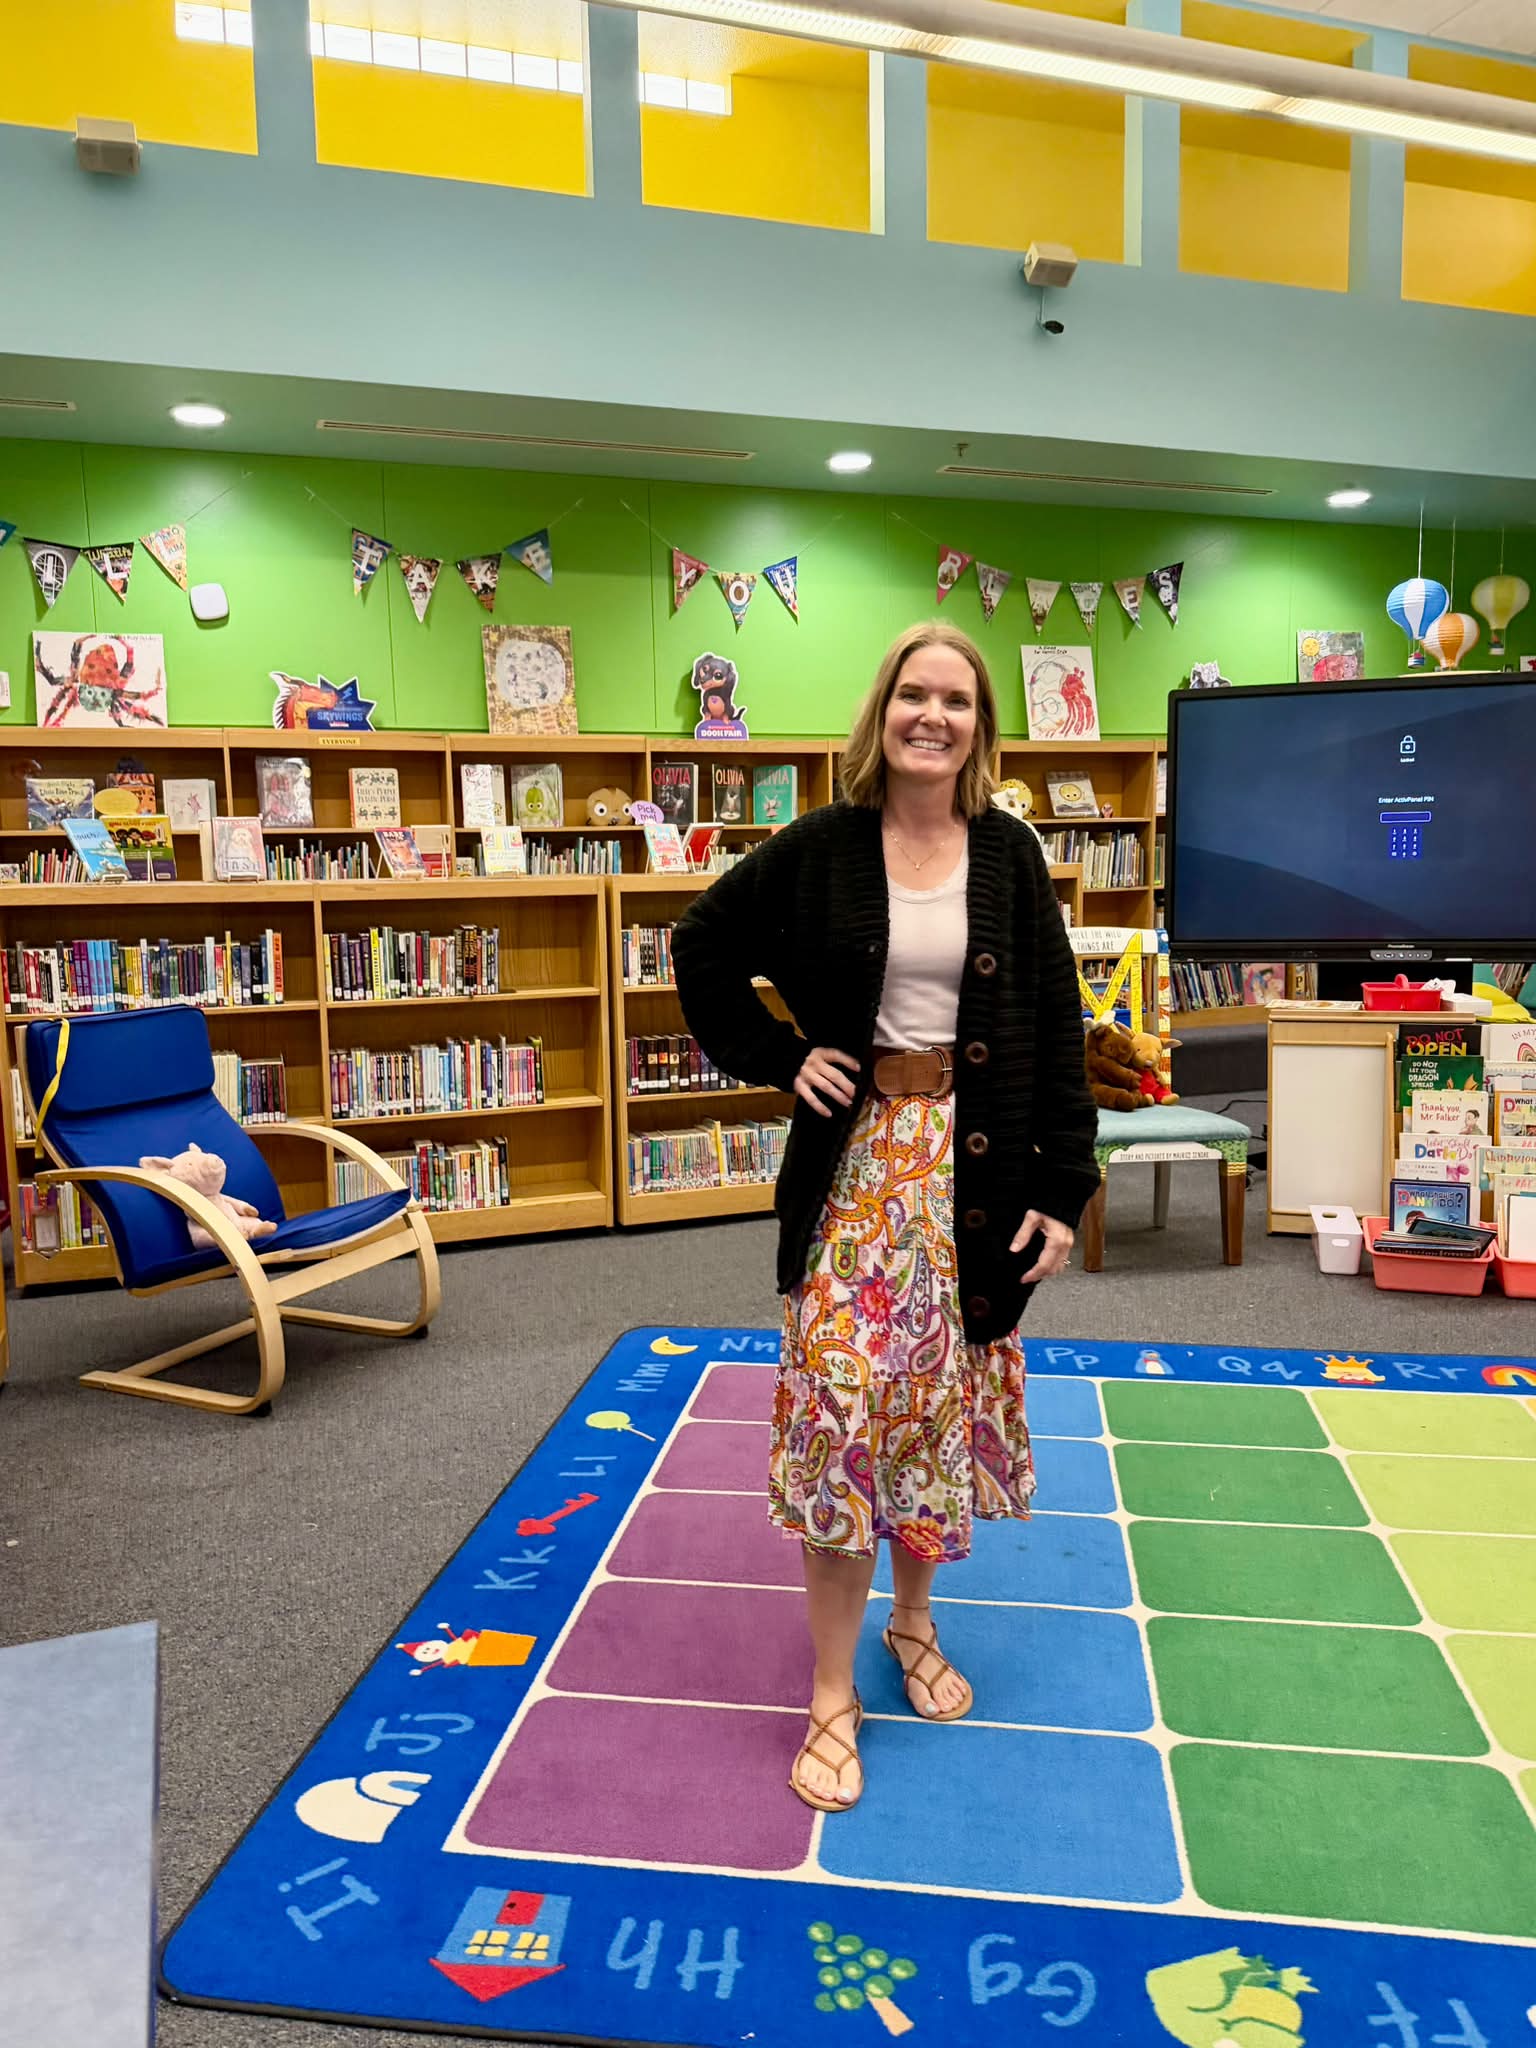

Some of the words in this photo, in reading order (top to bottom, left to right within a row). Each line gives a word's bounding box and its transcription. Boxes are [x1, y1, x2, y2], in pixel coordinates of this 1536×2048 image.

[317, 711, 363, 722] SKYWINGS
[701, 729, 721, 737] BOOK
[724, 729, 742, 737] FAIR
[653, 767, 691, 786] OLIVIA
[715, 768, 745, 786] OLIVIA
[755, 769, 790, 787] OLIVIA
[637, 804, 656, 814] Pick
[1102, 941, 1115, 951] ARE
[1405, 1034, 1432, 1049] DO
[1435, 1028, 1465, 1043] NOT
[1406, 1041, 1467, 1056] OPEN
[1408, 1073, 1439, 1081] DRAGON
[1420, 1104, 1445, 1112] Thank
[1436, 1113, 1460, 1121] Falker
[719, 1336, 777, 1353] Nn
[1044, 1346, 1100, 1370] Pp
[616, 1363, 671, 1392] Mm
[1217, 1355, 1303, 1382] Qq
[1393, 1361, 1468, 1380] Rr
[473, 1545, 557, 1589] Kk
[364, 1712, 476, 1756] Jj
[277, 1856, 381, 1942] Ii
[606, 1916, 745, 2000] Hh
[967, 1933, 1097, 2027] Gg
